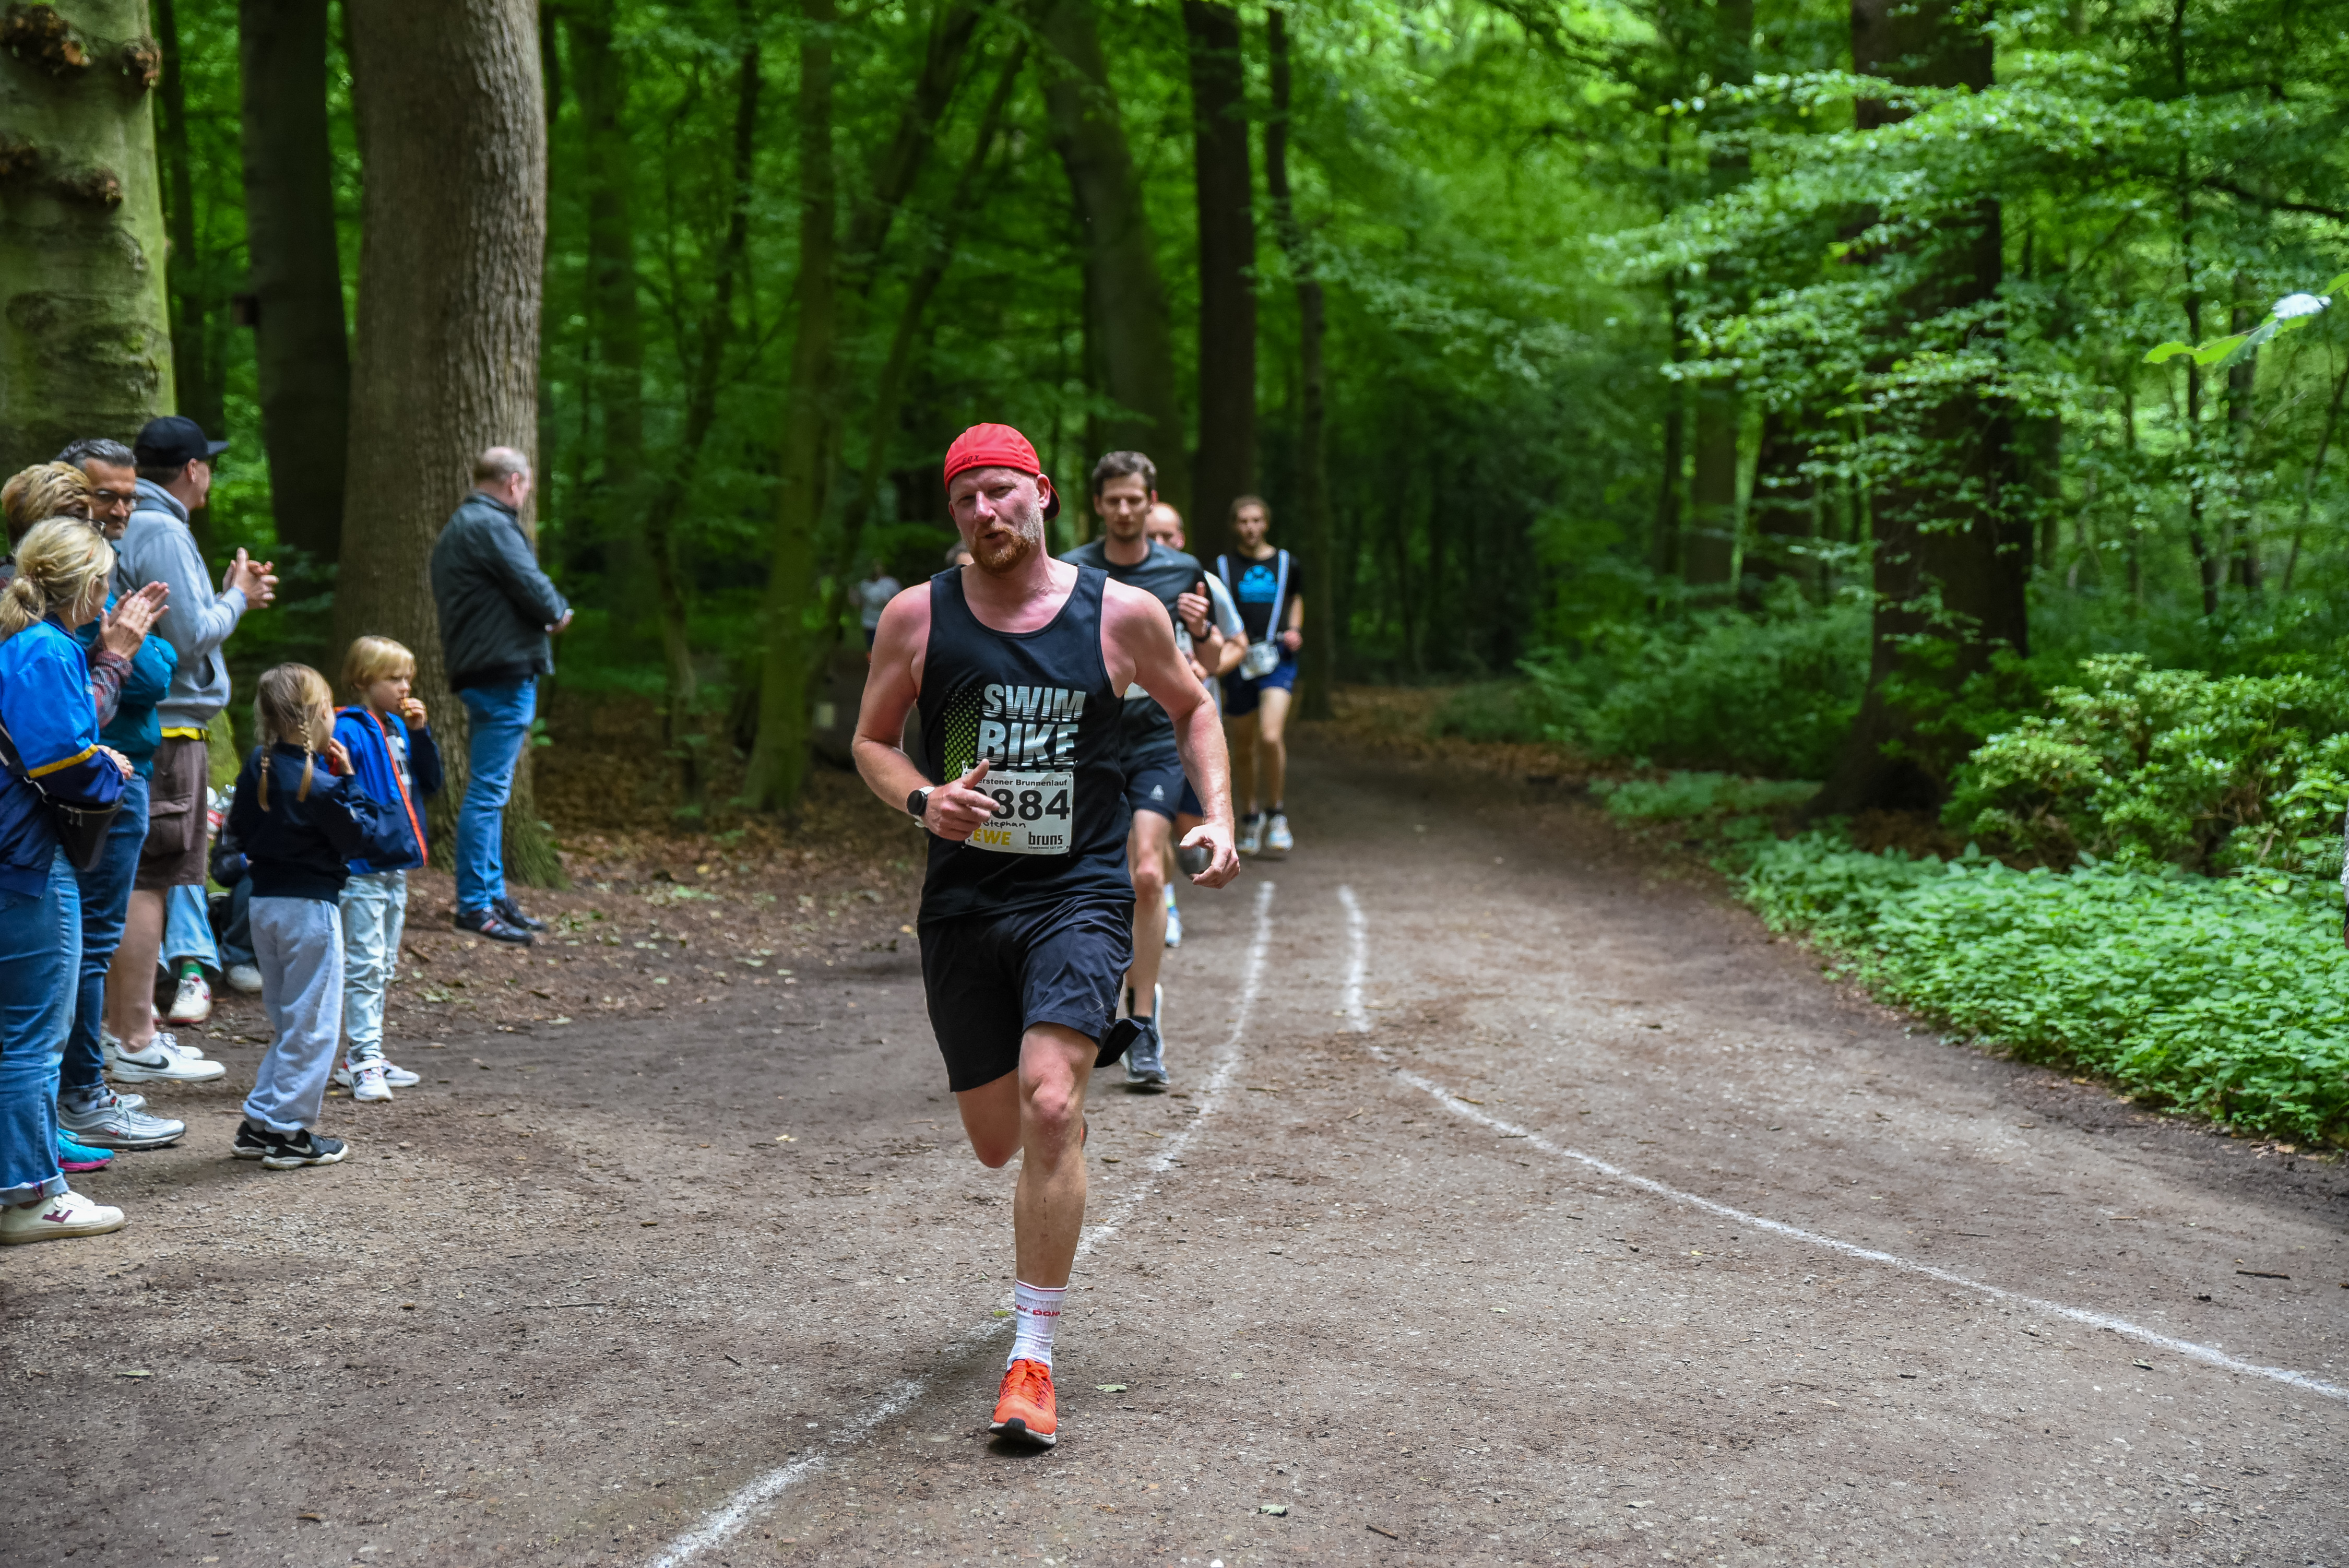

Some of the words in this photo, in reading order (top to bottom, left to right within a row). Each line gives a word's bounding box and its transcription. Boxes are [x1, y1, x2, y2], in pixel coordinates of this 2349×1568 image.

[982, 683, 1086, 722] SWIM
[976, 719, 1078, 767] BIKE
[974, 828, 1012, 846] EWE
[1028, 831, 1063, 845] bruns
